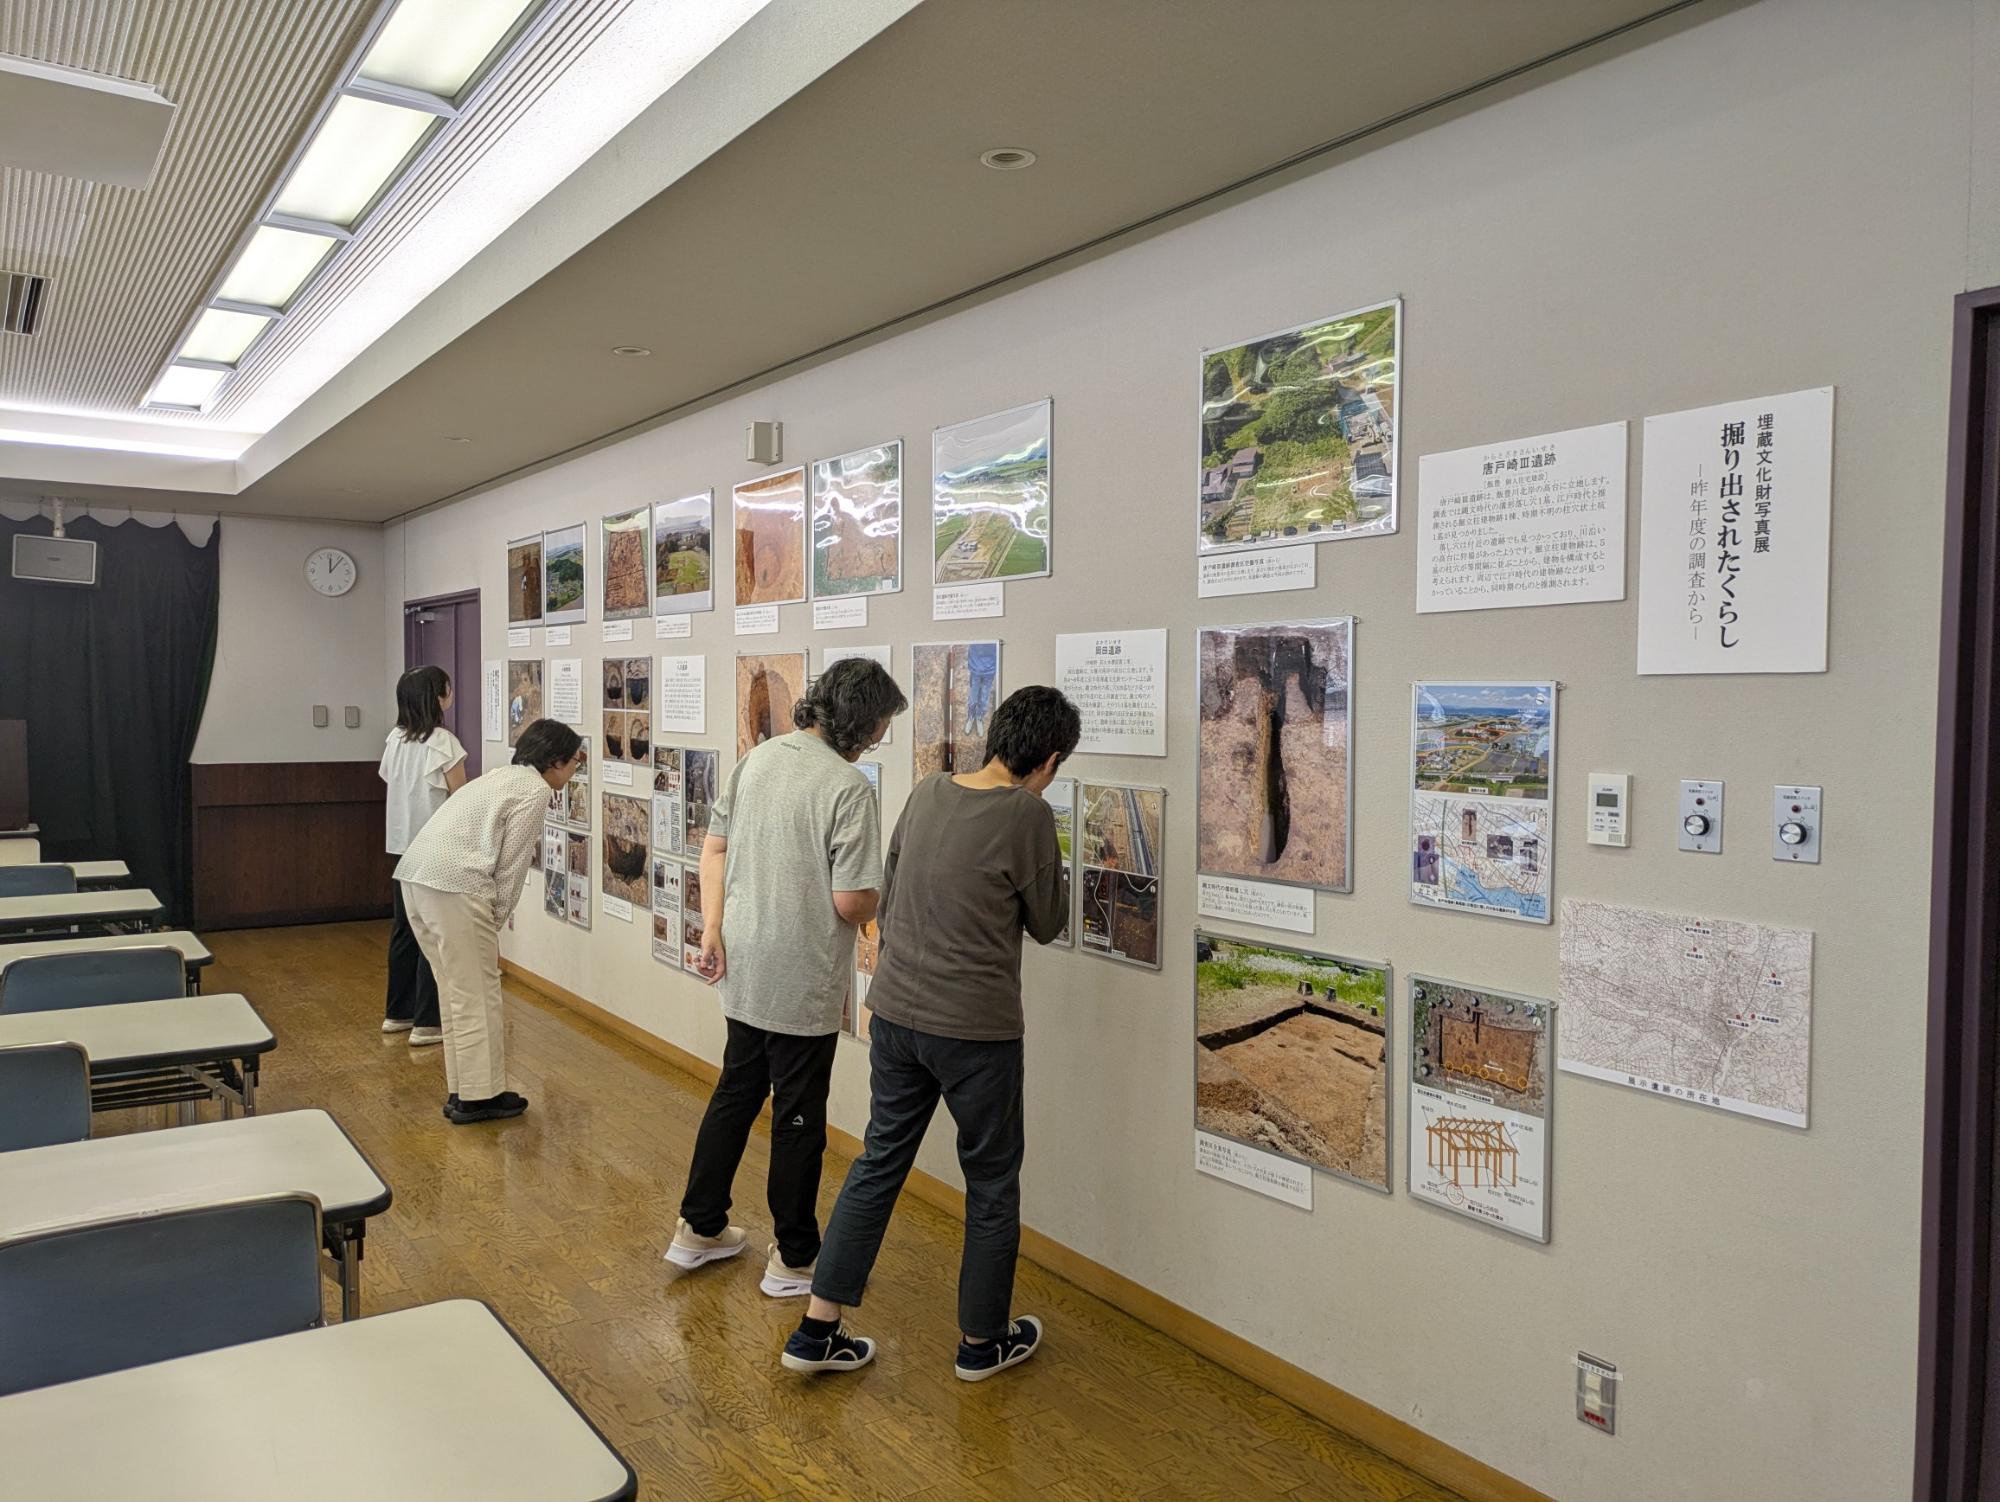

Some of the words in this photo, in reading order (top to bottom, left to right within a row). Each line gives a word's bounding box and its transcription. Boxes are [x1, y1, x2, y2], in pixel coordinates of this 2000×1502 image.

[1717, 421, 1745, 648] 掘り出されたくらし
[1753, 413, 1774, 554] 埋蔵文化財写真展
